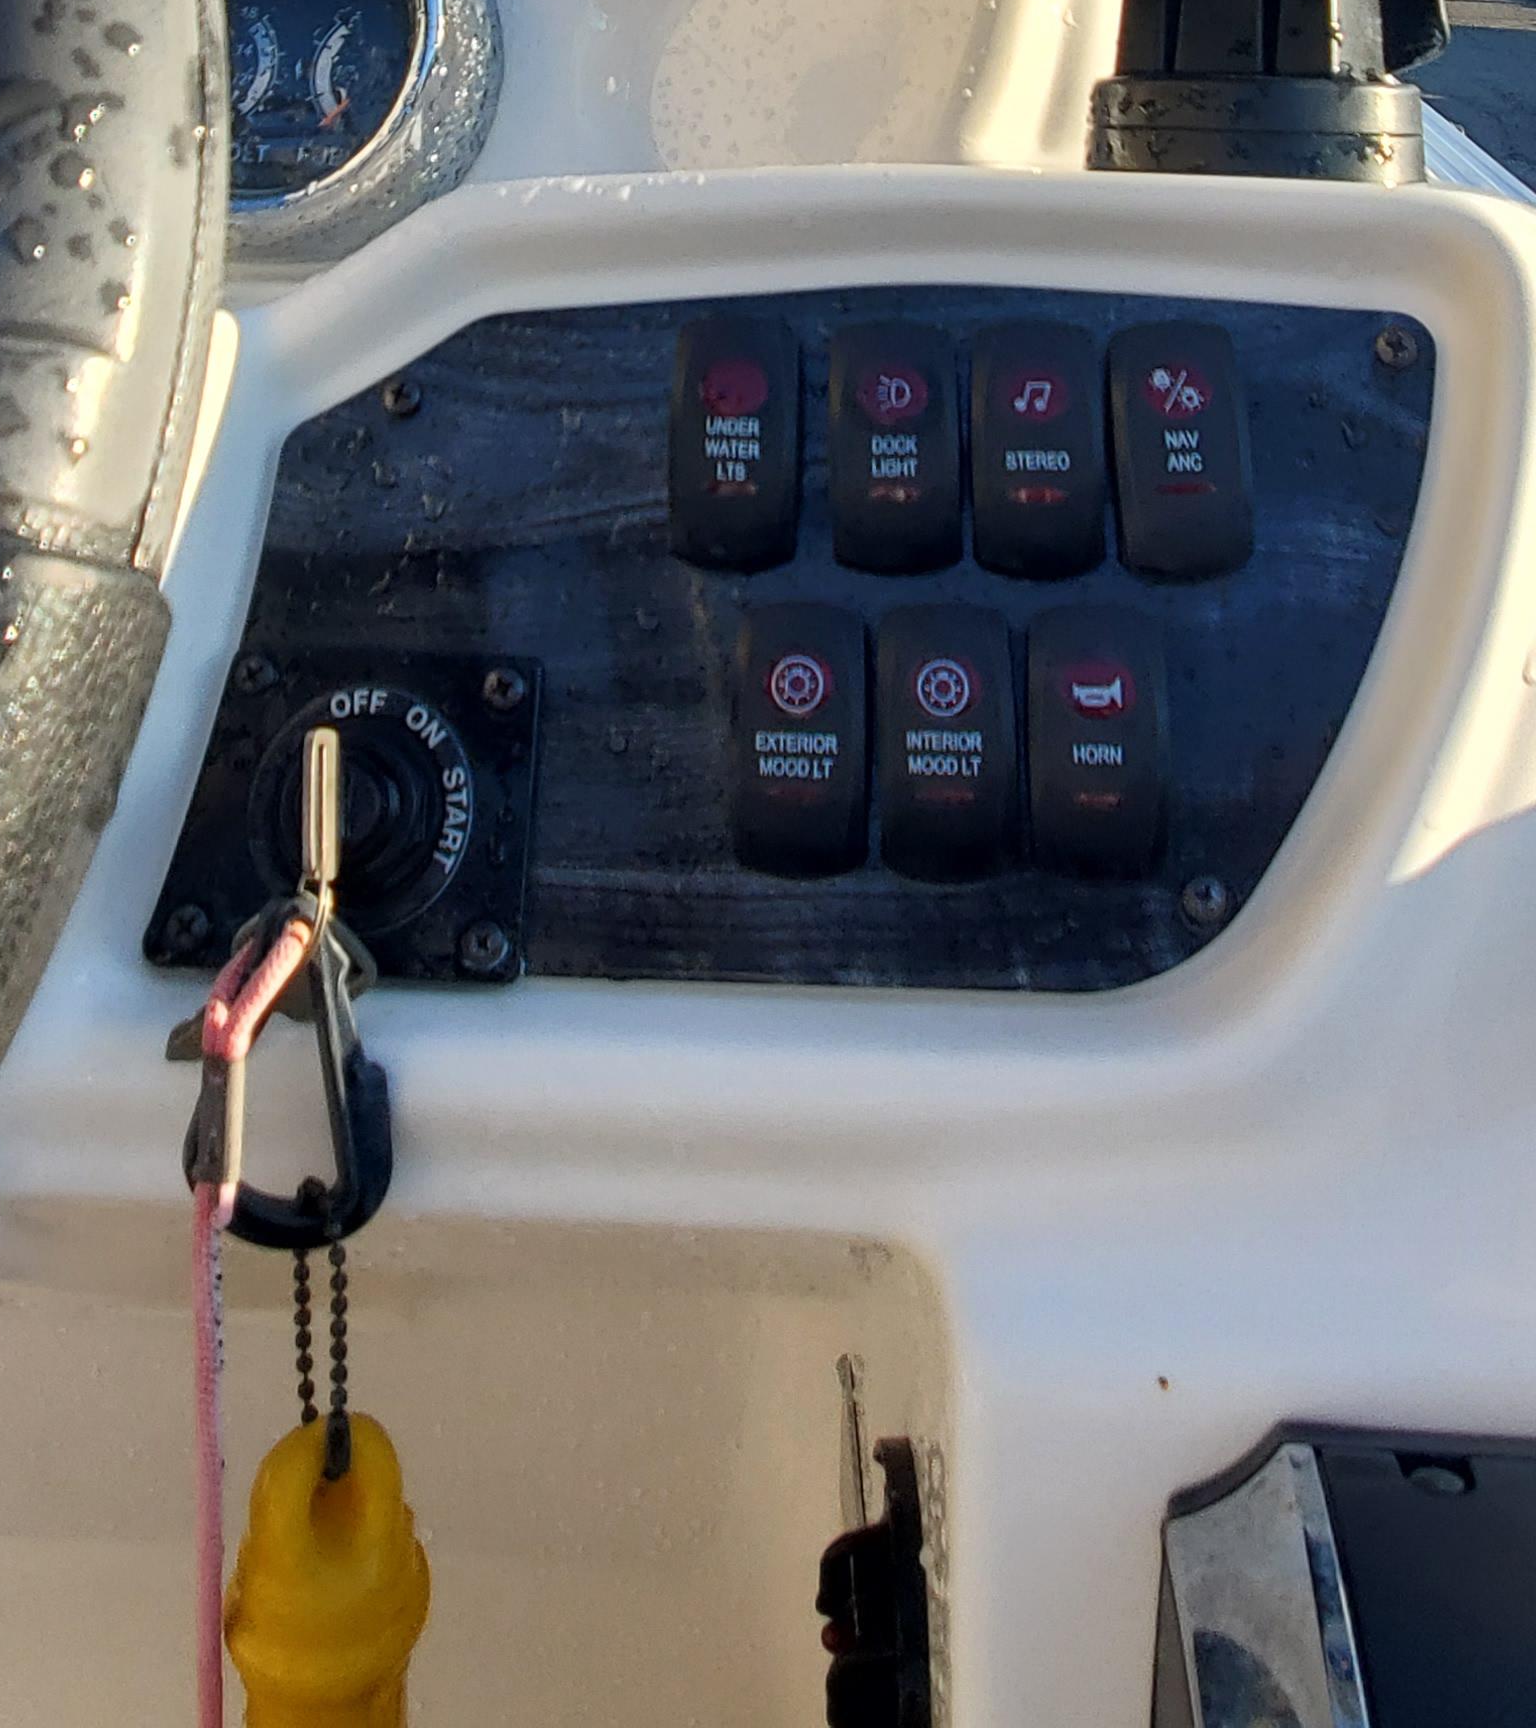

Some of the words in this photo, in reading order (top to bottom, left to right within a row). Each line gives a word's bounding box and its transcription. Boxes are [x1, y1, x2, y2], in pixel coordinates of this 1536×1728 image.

[705, 415, 760, 437] UNDER
[705, 437, 761, 460] WATER
[871, 434, 918, 455] DOCK
[1164, 429, 1200, 450] NAV
[871, 456, 918, 478] LIGHT
[1005, 450, 1071, 472] STEREO
[755, 730, 838, 755] EXTERIOR
[905, 730, 983, 753] INTERIOR
[908, 754, 958, 777] MOOD
[961, 755, 983, 778] LT
[1071, 743, 1124, 767] HORN
[759, 756, 810, 778] MOOD
[812, 758, 834, 780] LT
[330, 688, 388, 719] OFF
[405, 704, 448, 750] ON
[433, 766, 466, 875] START
